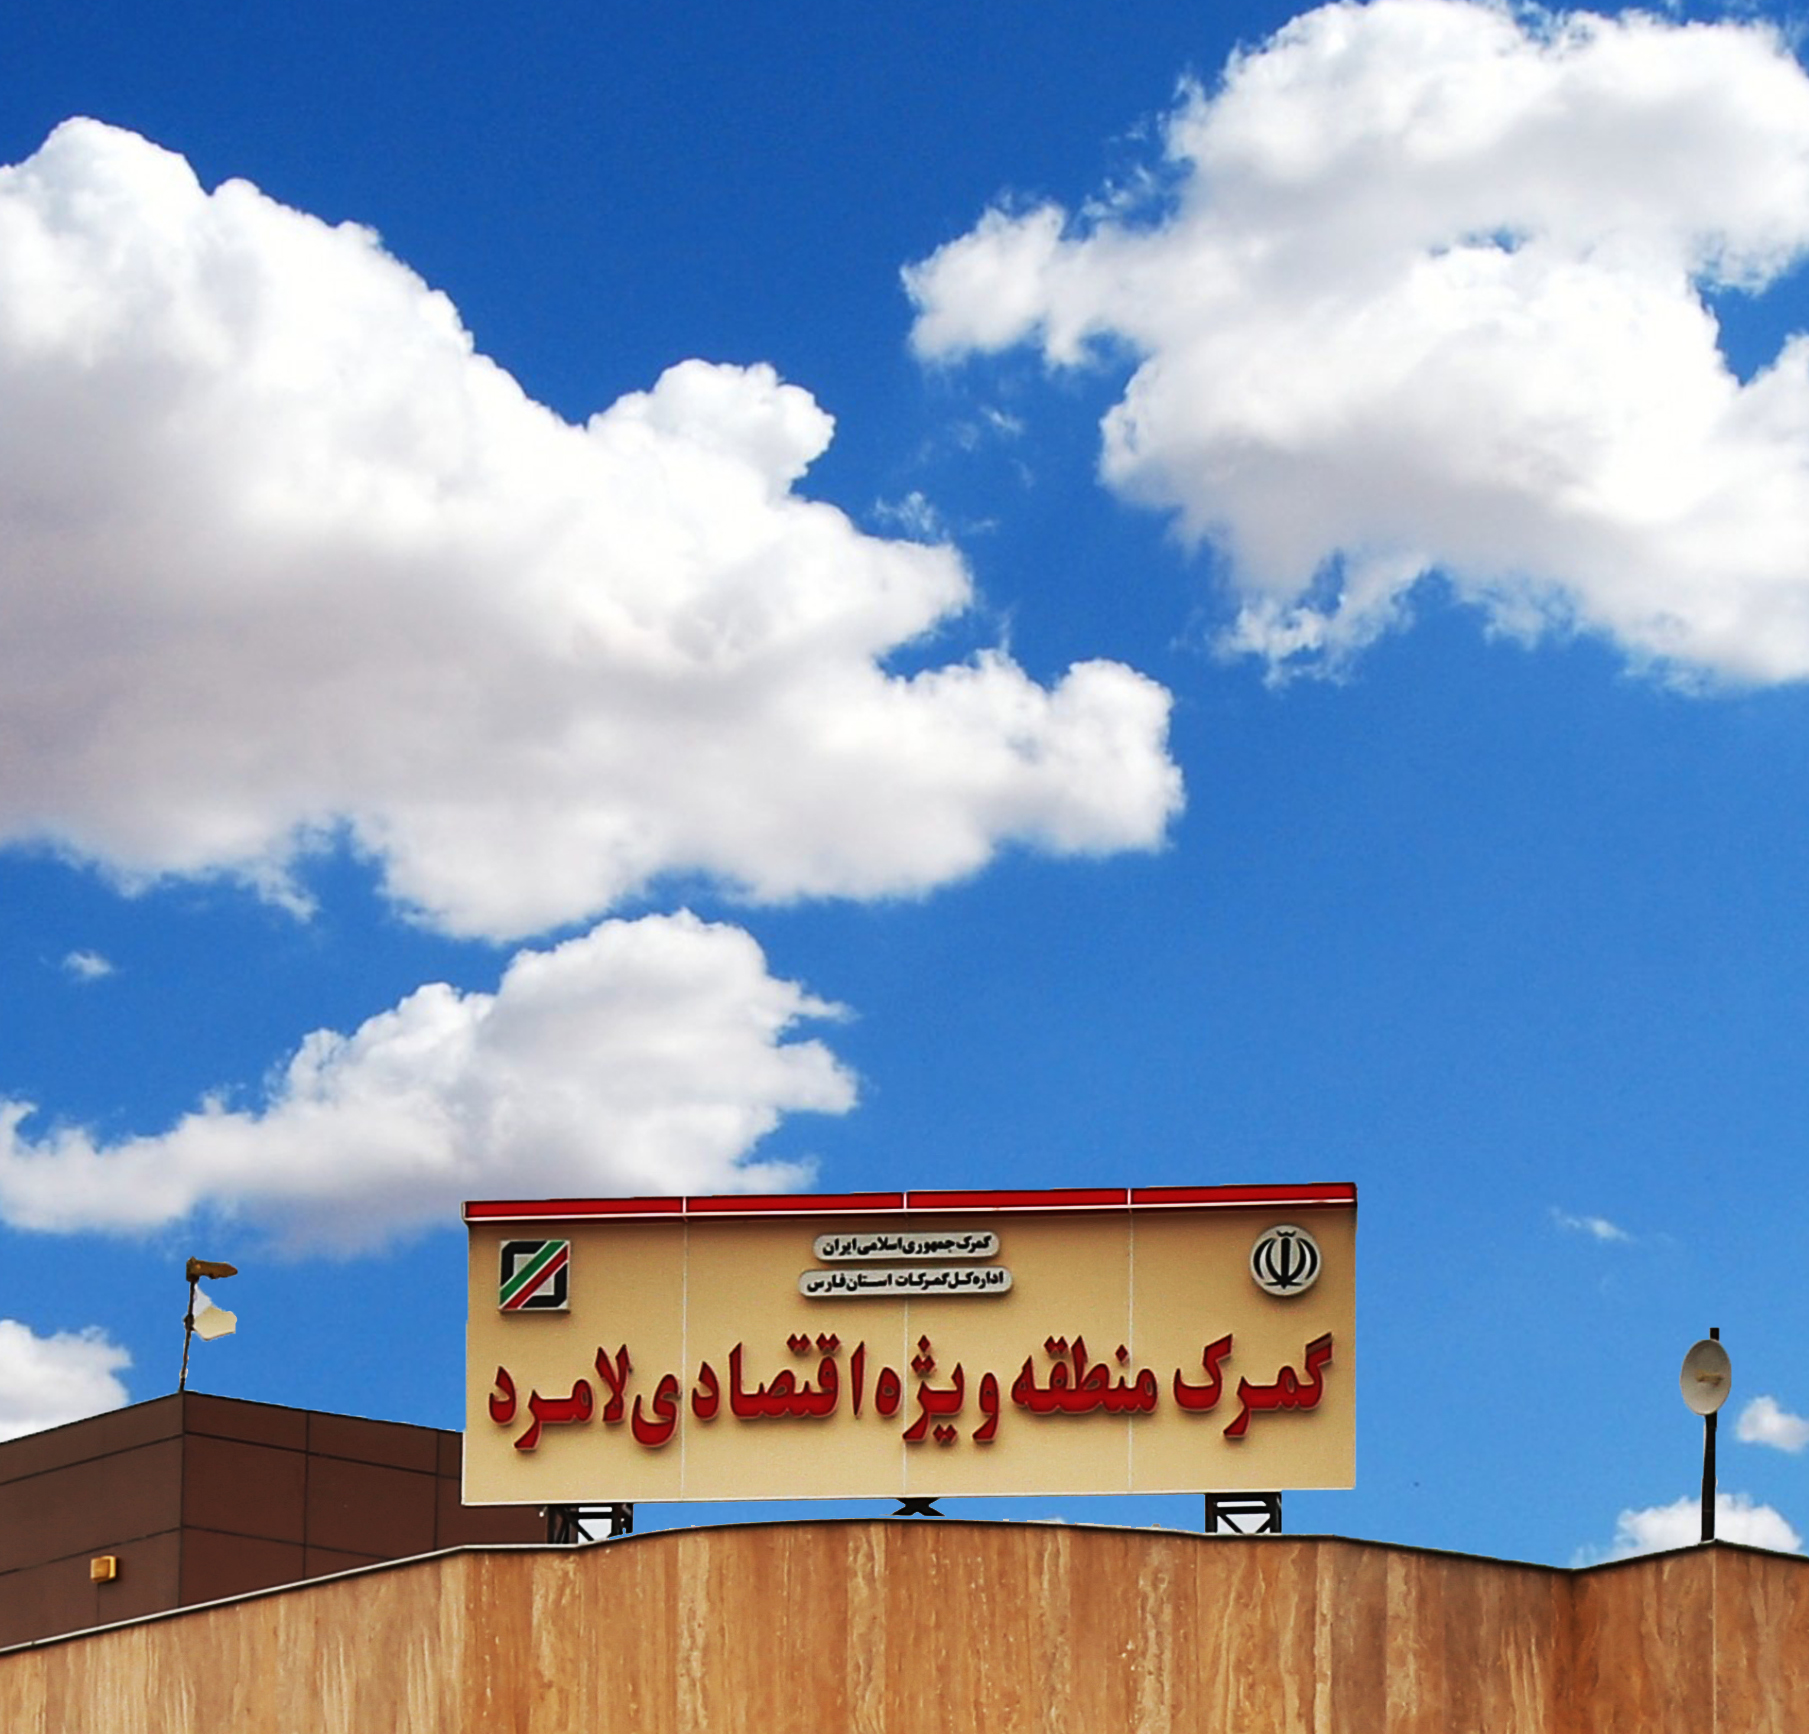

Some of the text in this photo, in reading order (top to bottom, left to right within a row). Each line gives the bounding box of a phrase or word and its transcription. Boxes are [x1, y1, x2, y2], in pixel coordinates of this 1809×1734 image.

[822, 1238, 857, 1256] ایران
[857, 1236, 903, 1255] اسلامی
[902, 1239, 955, 1254] جمهوری
[807, 1273, 846, 1292] فارس
[846, 1273, 893, 1291] استان
[948, 1271, 974, 1289] کل
[973, 1270, 1004, 1289] اداره
[488, 1332, 1333, 1450] گمرک منطقه ویژه اقتصادی لامرد
